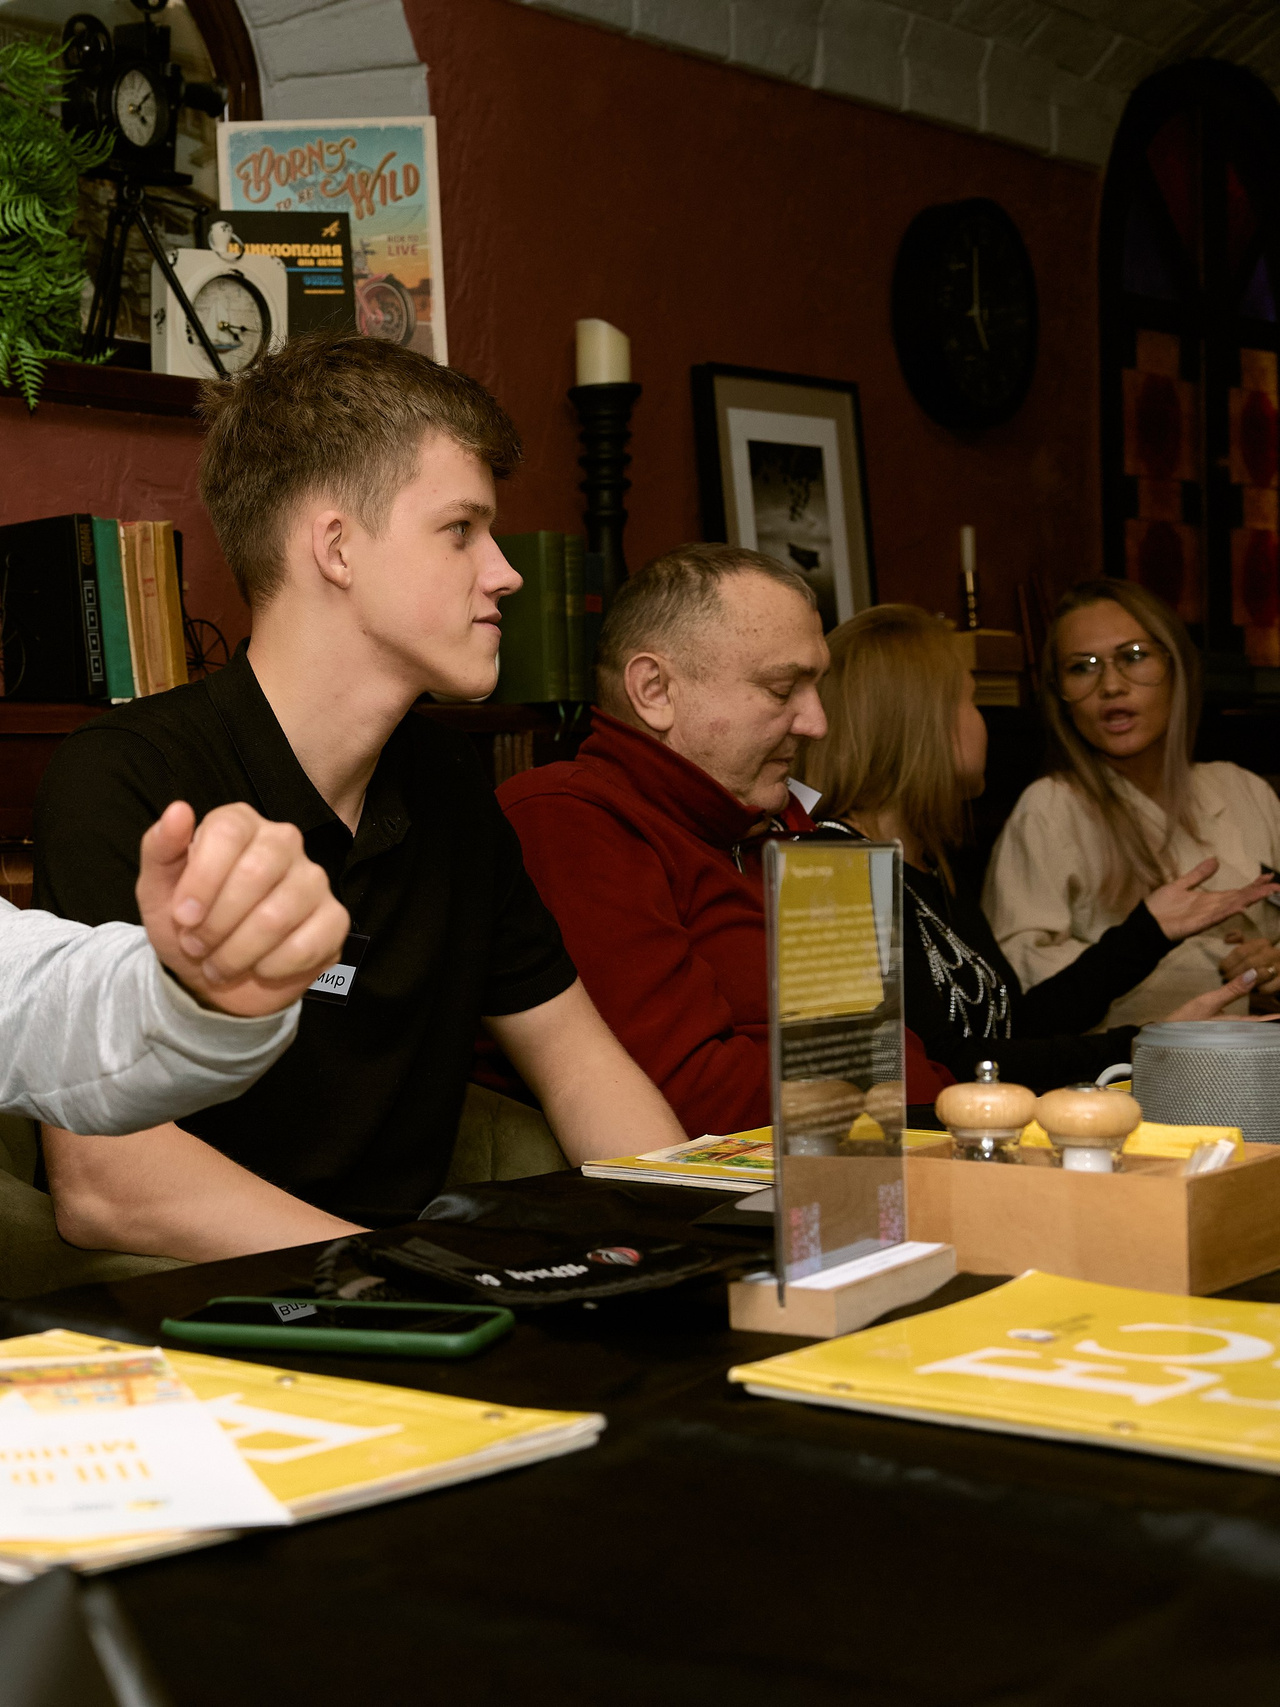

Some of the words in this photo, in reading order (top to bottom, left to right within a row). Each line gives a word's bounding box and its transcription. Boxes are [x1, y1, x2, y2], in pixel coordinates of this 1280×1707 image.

[235, 136, 357, 203] BORN
[320, 151, 420, 220] WILD
[387, 245, 419, 257] LIVE
